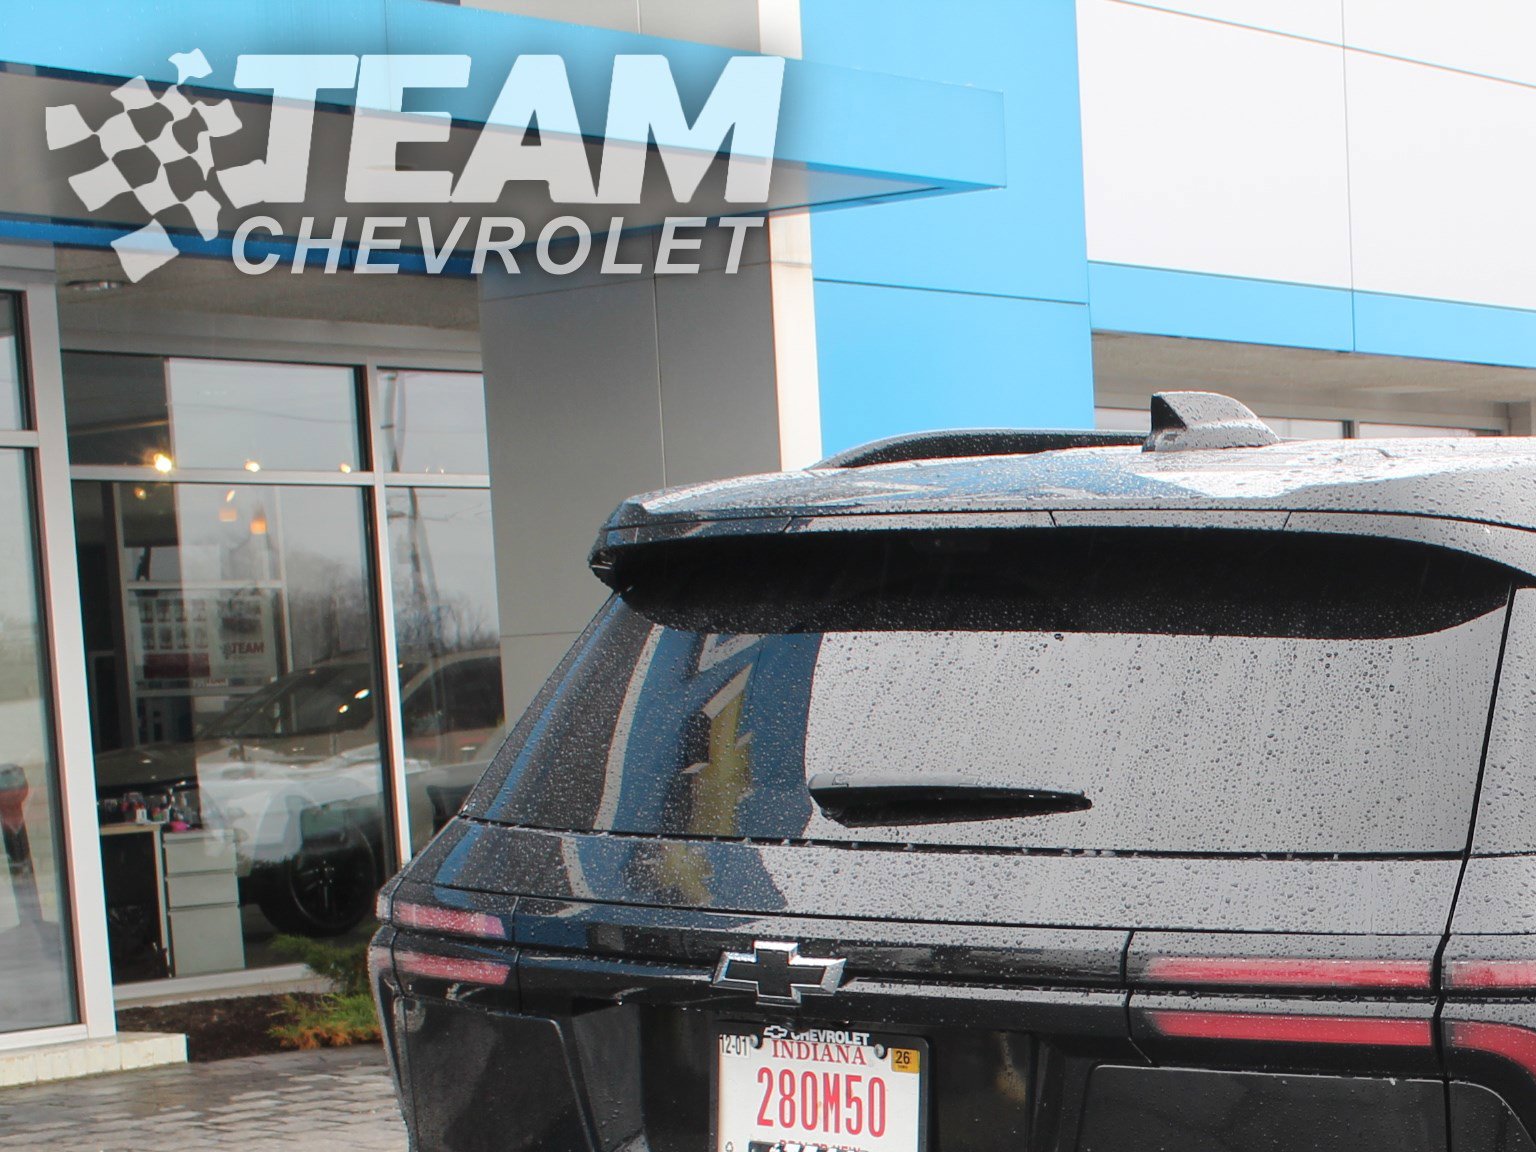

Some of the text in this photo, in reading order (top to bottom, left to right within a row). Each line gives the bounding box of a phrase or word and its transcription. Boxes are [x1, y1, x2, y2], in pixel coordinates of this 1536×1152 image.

[230, 642, 265, 654] TEAM
[772, 1039, 867, 1066] INDIANA
[895, 1050, 911, 1065] 26
[757, 1066, 887, 1138] 280M50
